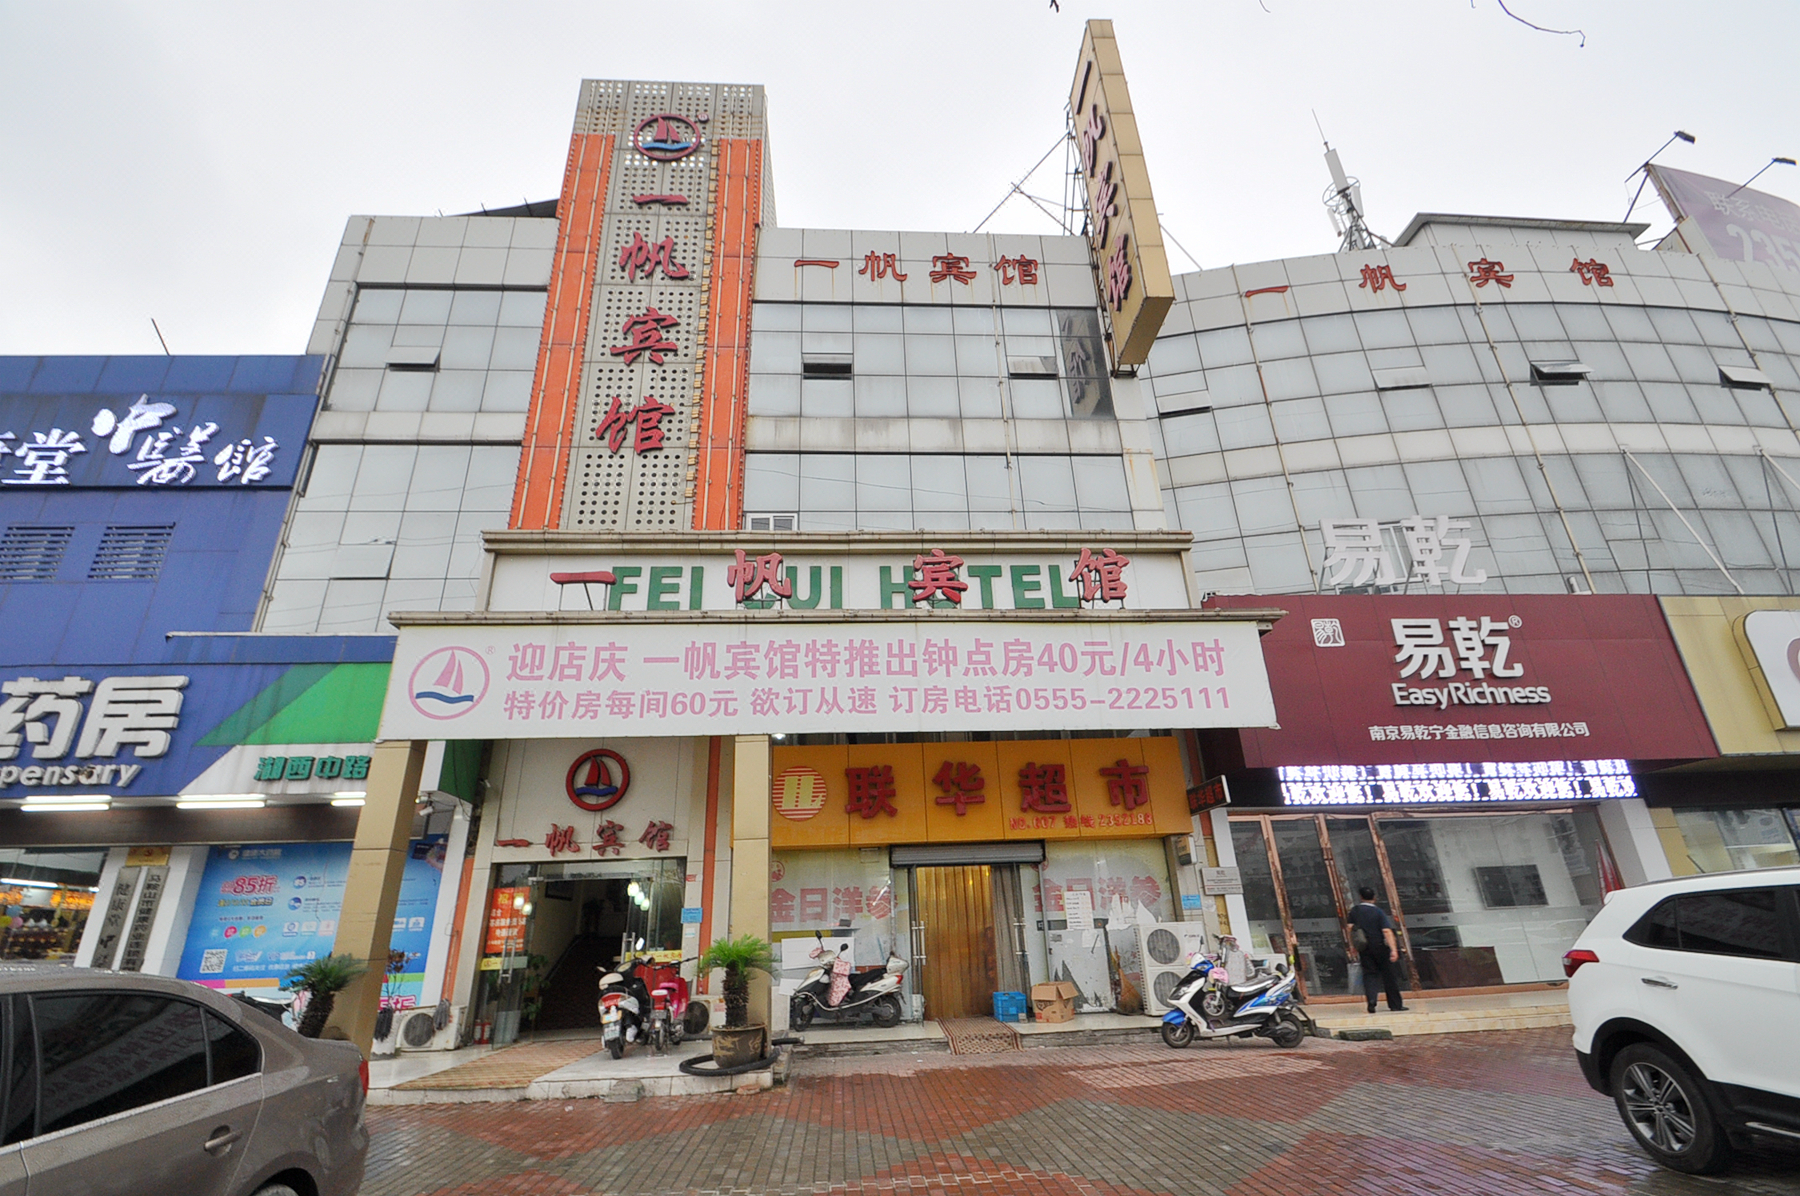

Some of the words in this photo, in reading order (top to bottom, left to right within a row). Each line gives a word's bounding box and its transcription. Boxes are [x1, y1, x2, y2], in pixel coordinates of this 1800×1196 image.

[793, 250, 1039, 286] 一帆宾馆
[1244, 257, 1615, 292] 一帆宾馆
[596, 193, 691, 455] 一帆宾馆
[1319, 515, 1488, 587] 易乾
[550, 549, 1130, 604] 一帆宾馆
[608, 566, 704, 611] FEI
[879, 564, 1080, 609] HTEL
[505, 641, 629, 683] 迎店庆
[642, 637, 1226, 680] 一帆宾馆特推出钟点房40元/4小时
[1390, 615, 1525, 680] 易乾
[0, 675, 190, 760] 药房
[503, 689, 739, 720] 特价房每间60元
[750, 686, 878, 717] 欲订从速
[888, 684, 1231, 715] 订房电话0555-2225111
[1391, 682, 1552, 711] EasyRichness
[1368, 722, 1591, 742] 南京易乾宁金融信息咨询有限公司
[253, 755, 372, 781] 湖西中路
[844, 758, 1150, 820] 联华超市
[496, 819, 674, 857] 一帆宾馆
